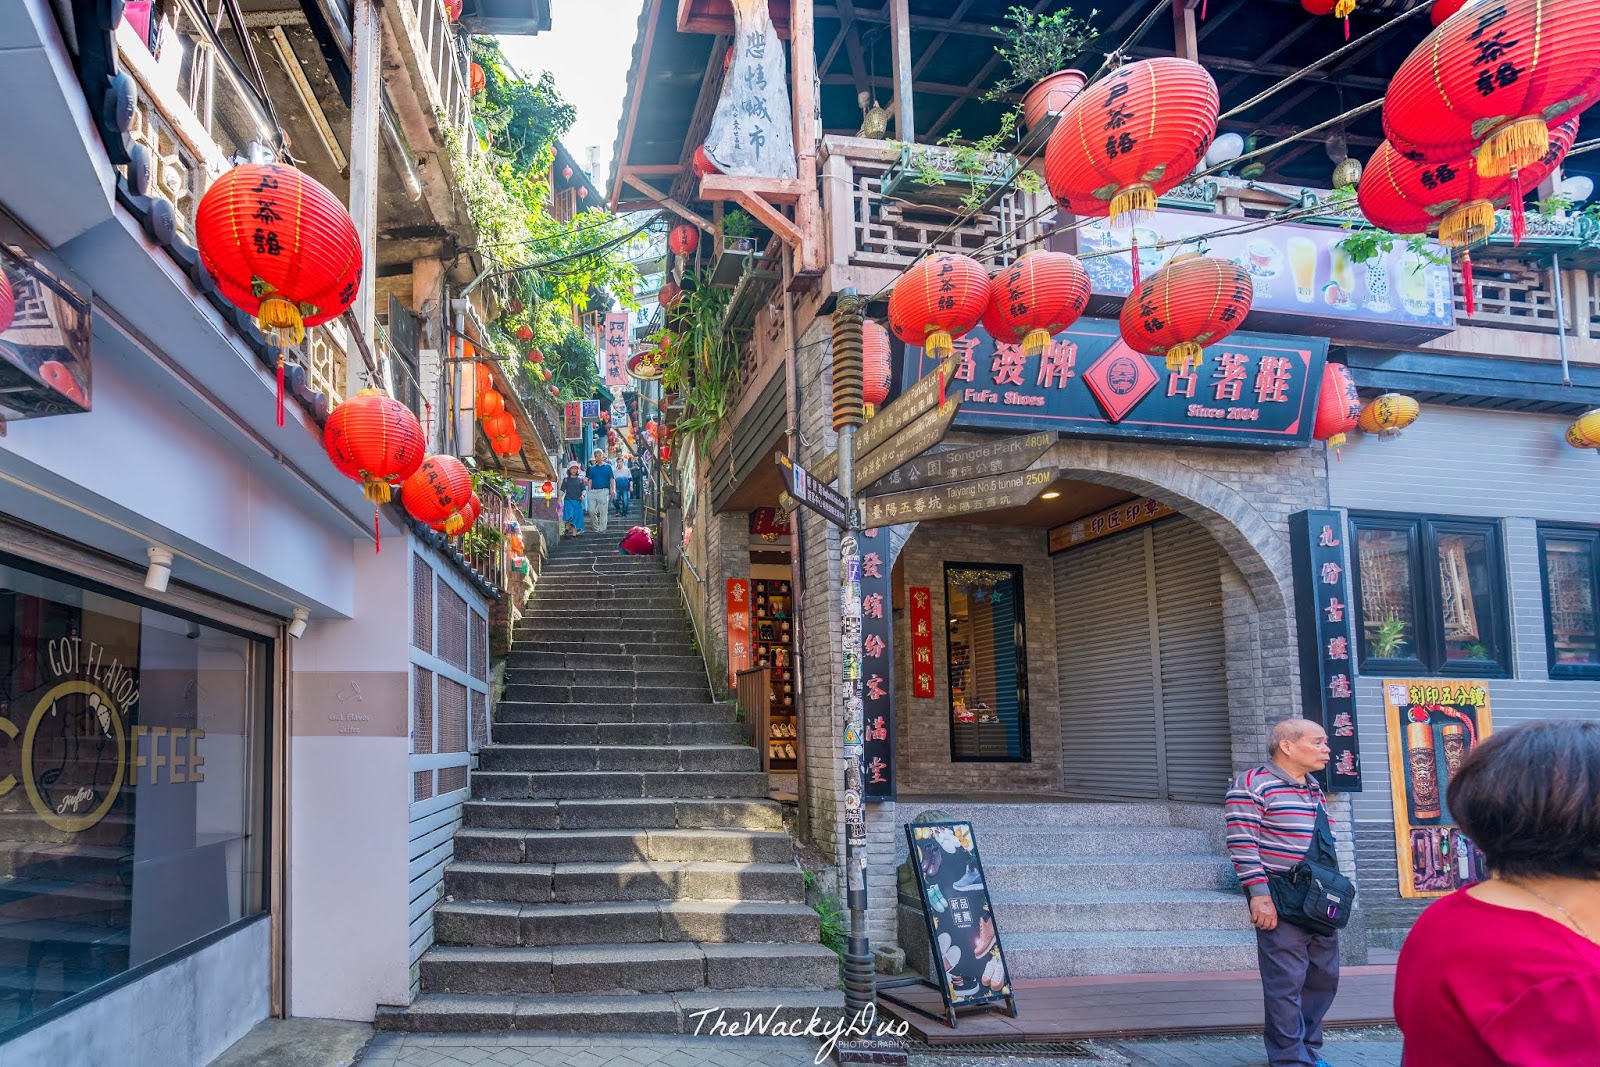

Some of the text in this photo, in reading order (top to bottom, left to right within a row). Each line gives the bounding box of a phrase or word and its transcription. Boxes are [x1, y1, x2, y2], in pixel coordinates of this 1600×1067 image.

[741, 31, 772, 161] 悲情城市
[608, 321, 625, 378] 阿妹茶樓
[928, 373, 937, 387] Lot
[964, 388, 1046, 407] FuFa Shoes
[1187, 404, 1260, 421] Since 2004
[946, 446, 991, 464] Songde
[993, 441, 1022, 455] Park
[946, 472, 1050, 499] Taiyang No.5 tunnel 250M
[1091, 498, 1172, 534] 印匠印章
[48, 636, 140, 715] GOT FLAVOR
[1409, 685, 1485, 706] 刻印五分鐘
[951, 899, 968, 910] 新品
